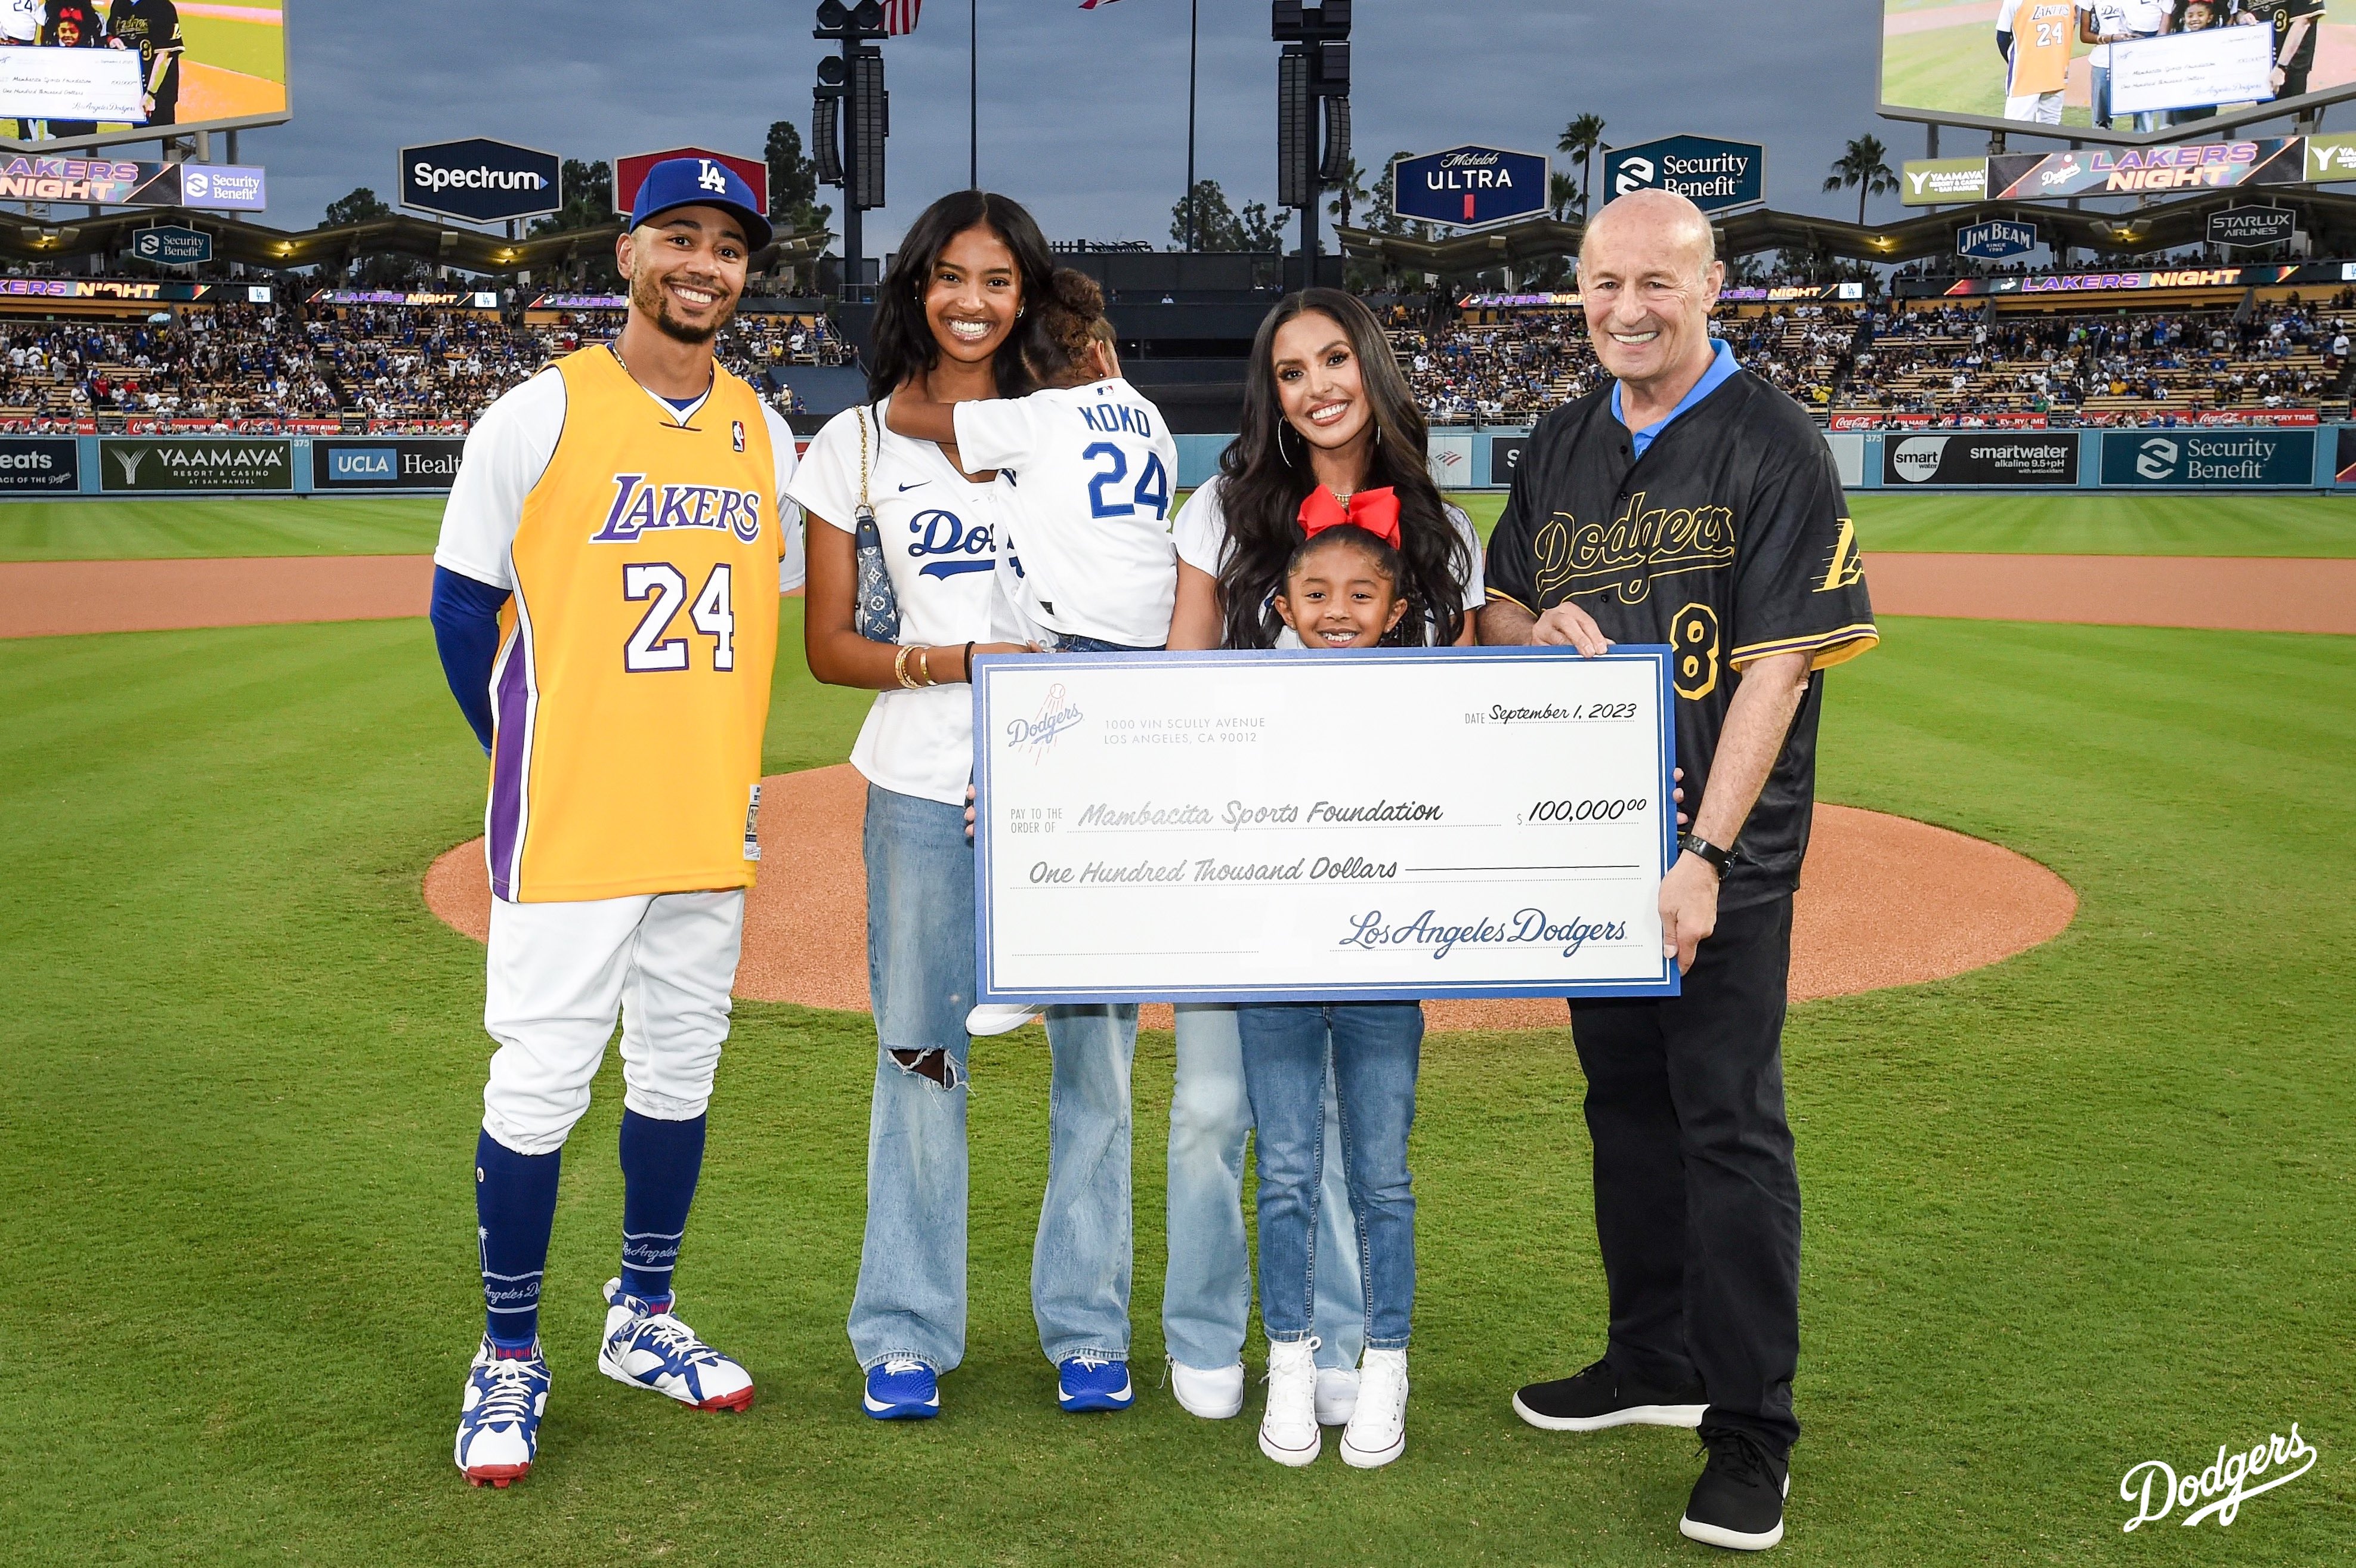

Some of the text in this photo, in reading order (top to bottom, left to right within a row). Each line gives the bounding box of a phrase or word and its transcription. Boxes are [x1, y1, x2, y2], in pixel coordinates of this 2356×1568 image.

[2036, 21, 2063, 47] 24
[140, 39, 152, 61] 8
[1439, 152, 1499, 168] Michelob
[1663, 152, 1749, 177] Security
[2091, 142, 2258, 171] LAKERS
[0, 157, 138, 182] AKERS
[415, 162, 539, 192] Spectrum
[697, 159, 726, 194] LA
[1427, 168, 1513, 191] ULTRA
[2106, 166, 2230, 191] NIGHT
[212, 174, 260, 191] Security
[1664, 175, 1736, 197] Benefit
[213, 187, 256, 200] Benefit
[2212, 214, 2290, 229] STARLUX
[2224, 227, 2278, 237] AIRLINES
[163, 234, 204, 248] Security
[1961, 223, 2030, 253] JIM BEAM
[164, 246, 200, 256] Benefit
[2021, 273, 2141, 292] LAKERS
[2149, 269, 2241, 287] NIGHT
[335, 292, 404, 303] LAKERS
[407, 293, 458, 304] NIGHT
[556, 296, 622, 307] LAKERS
[1482, 295, 1548, 305] LAKERS
[1769, 286, 1822, 298] NIGHT
[1077, 403, 1151, 438] KOKO
[293, 439, 309, 447] 375
[1866, 434, 1882, 443] 375
[0, 450, 52, 469] eats
[157, 446, 284, 467] YAAMAVA'
[1896, 451, 1938, 463] smart
[1969, 445, 2069, 459] smartwater
[2188, 438, 2276, 461] Security
[338, 456, 389, 473] UCLA
[1995, 459, 2064, 468] alkaline 9.5+pH
[2187, 459, 2262, 479] Benefit
[1082, 441, 1168, 521] 24
[588, 473, 762, 545] LAKERS
[1535, 491, 1735, 605] Dodgers
[623, 562, 734, 673] 24
[1670, 602, 1719, 701] 8
[1105, 717, 1266, 730] 1000 VIN SCULLY AVENUE
[1465, 712, 1486, 725] DATE
[1489, 704, 1570, 725] September
[1588, 703, 1637, 719] 2023
[1007, 703, 1084, 747] Dodgers
[1104, 732, 1257, 745] LOS ANGELES, CA 90012
[1010, 808, 1063, 820] PAY TO THE
[1078, 799, 1444, 832] Mambacita Sports Foundation
[1010, 822, 1056, 833] ORDER OF
[1029, 856, 1398, 884] One Hundred Thousand Dollars
[1338, 908, 1628, 960] Los Angeles Dodgers
[631, 1244, 677, 1264] Angeles
[484, 1284, 524, 1305] Angeles
